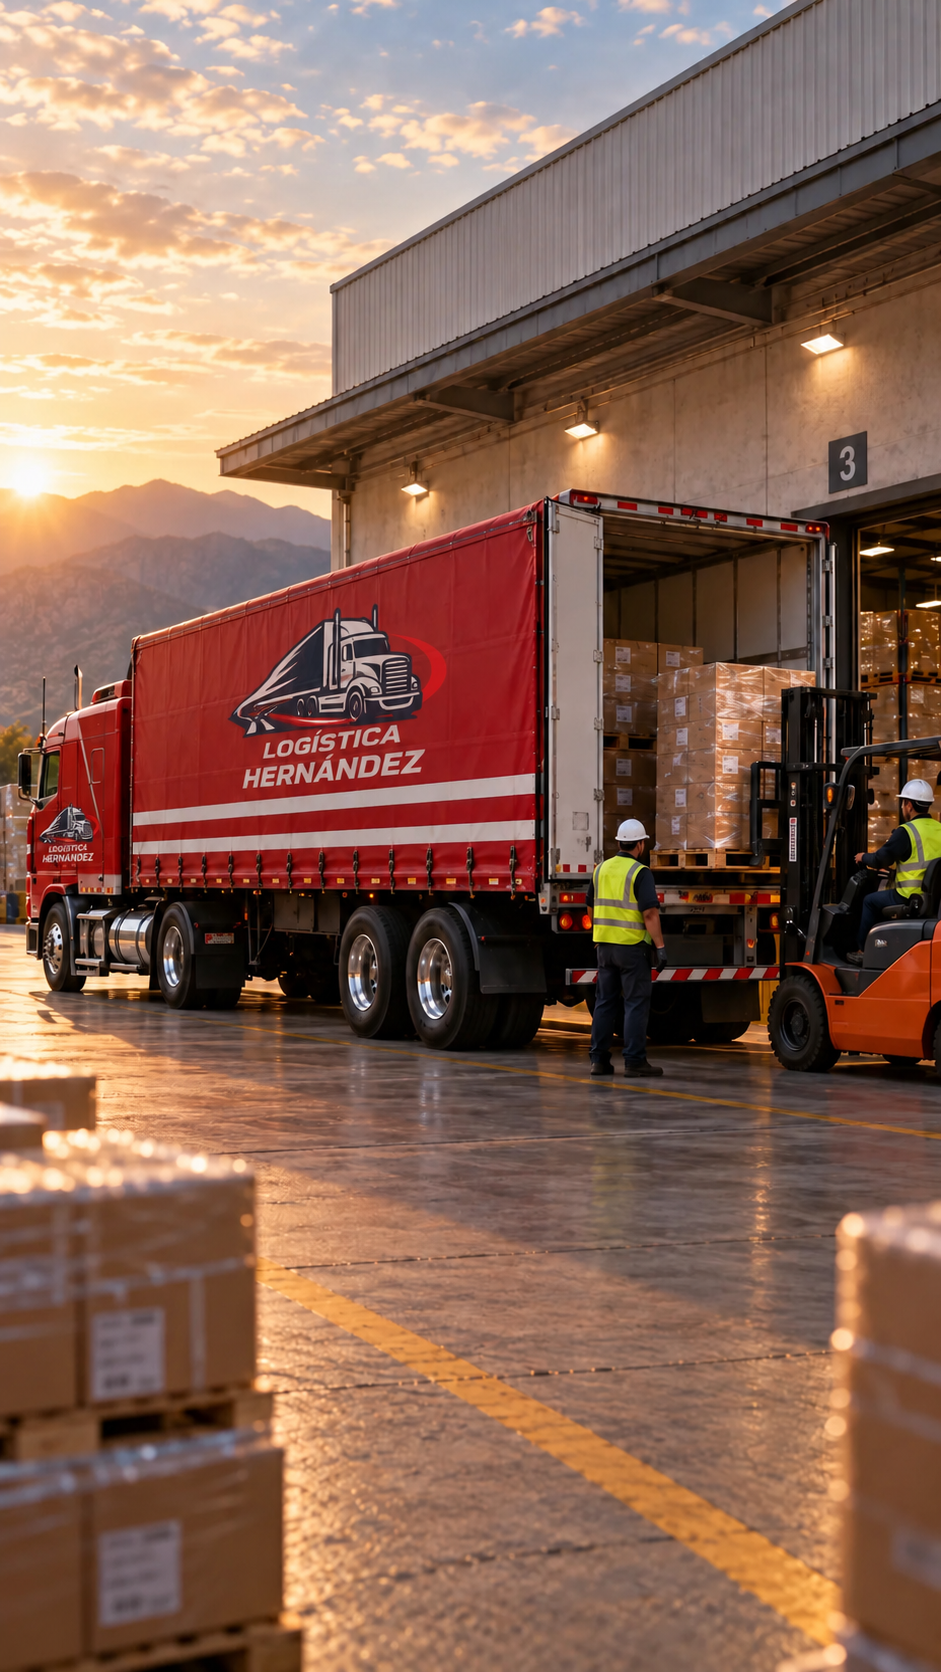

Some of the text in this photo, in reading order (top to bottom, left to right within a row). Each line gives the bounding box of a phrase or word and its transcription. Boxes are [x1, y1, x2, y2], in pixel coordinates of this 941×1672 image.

[839, 445, 856, 481] 3
[262, 724, 401, 760] LOGÍSTICA
[242, 749, 426, 789] HERNÁNDEZ
